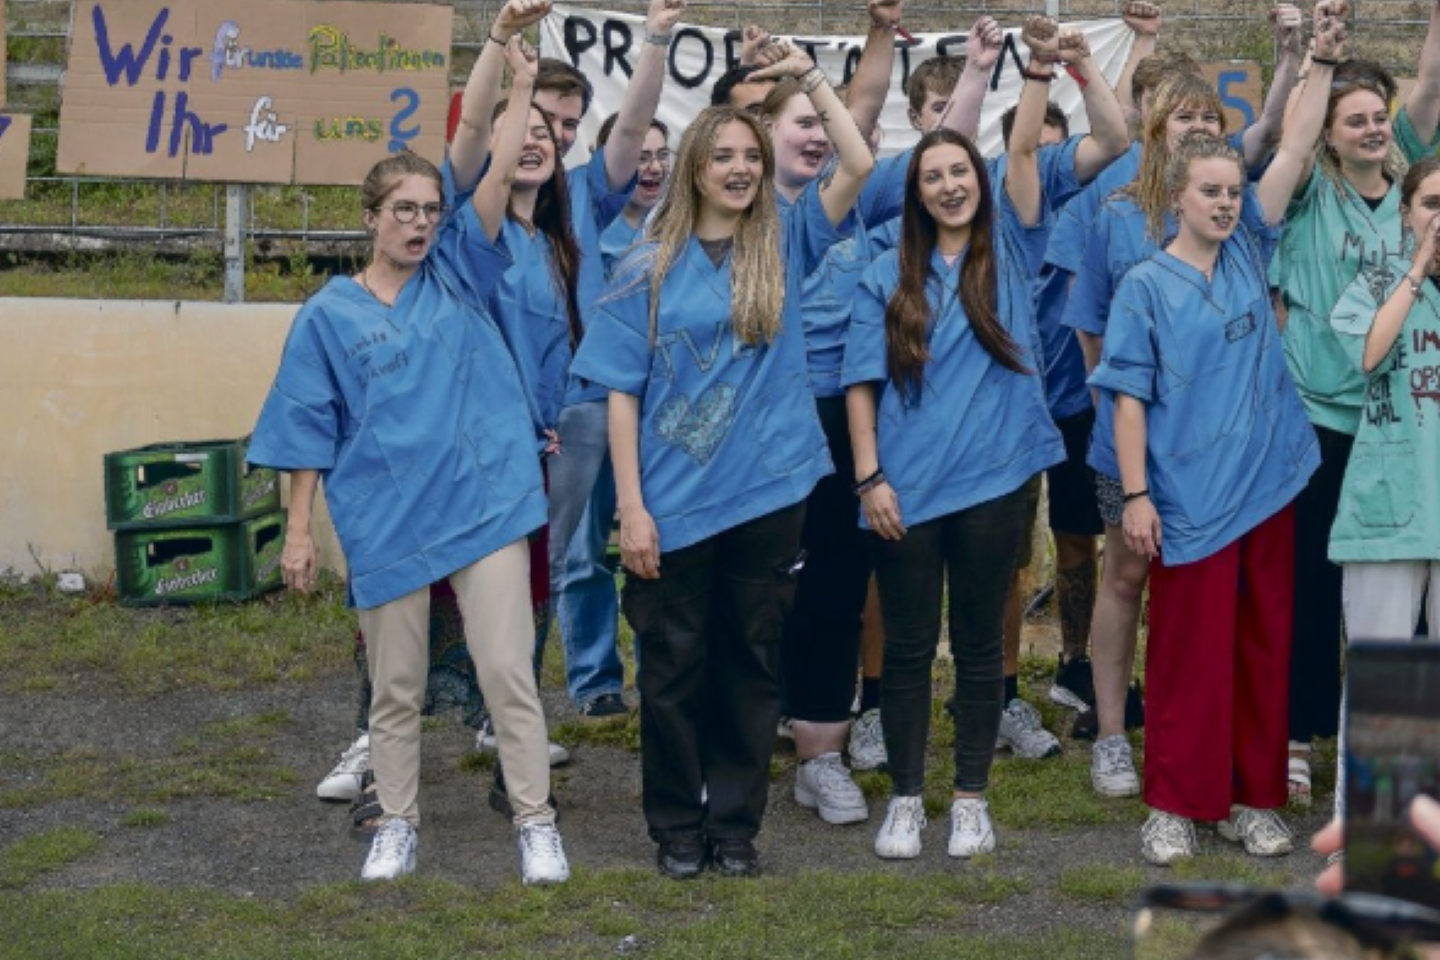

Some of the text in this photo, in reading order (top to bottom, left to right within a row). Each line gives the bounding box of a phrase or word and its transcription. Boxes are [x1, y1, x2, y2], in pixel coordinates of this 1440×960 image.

[92, 4, 202, 87] Wir
[145, 90, 227, 157] Ihr
[244, 95, 291, 152] für
